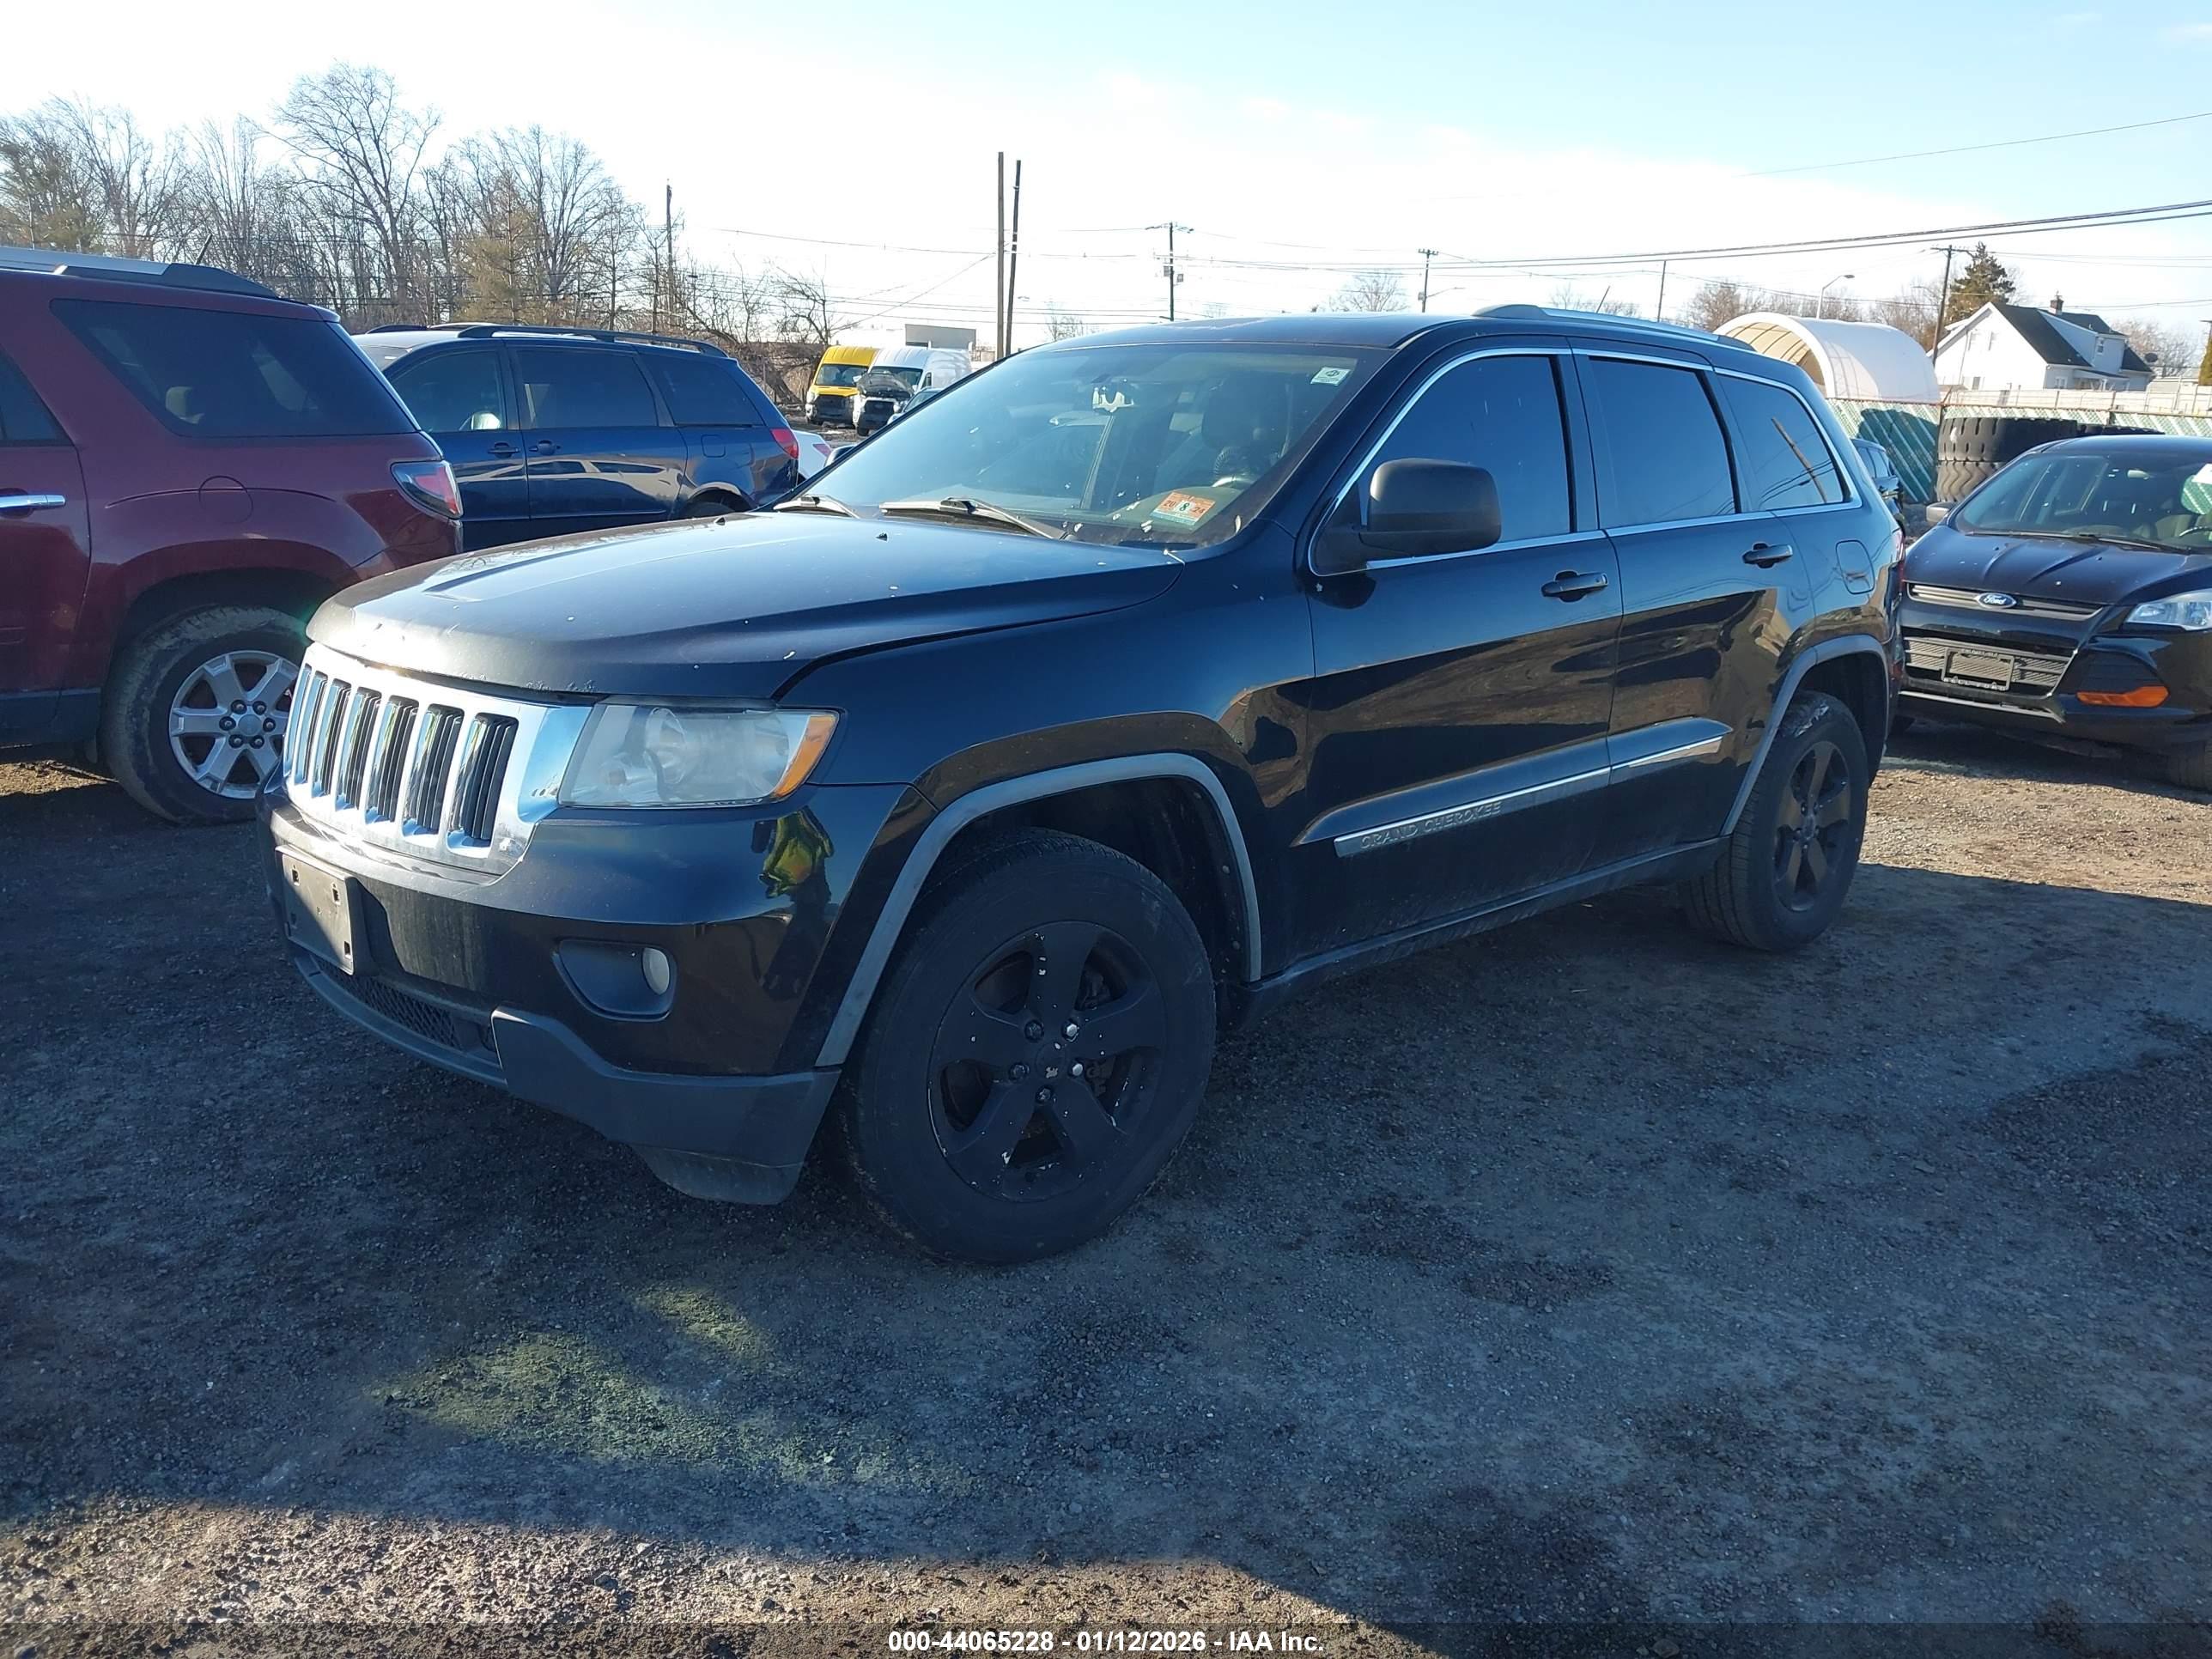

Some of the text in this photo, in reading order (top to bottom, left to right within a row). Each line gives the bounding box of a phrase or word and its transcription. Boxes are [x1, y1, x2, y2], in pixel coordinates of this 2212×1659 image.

[1179, 502, 1190, 512] 8
[1360, 801, 1503, 849] GRAND CHEROKEE
